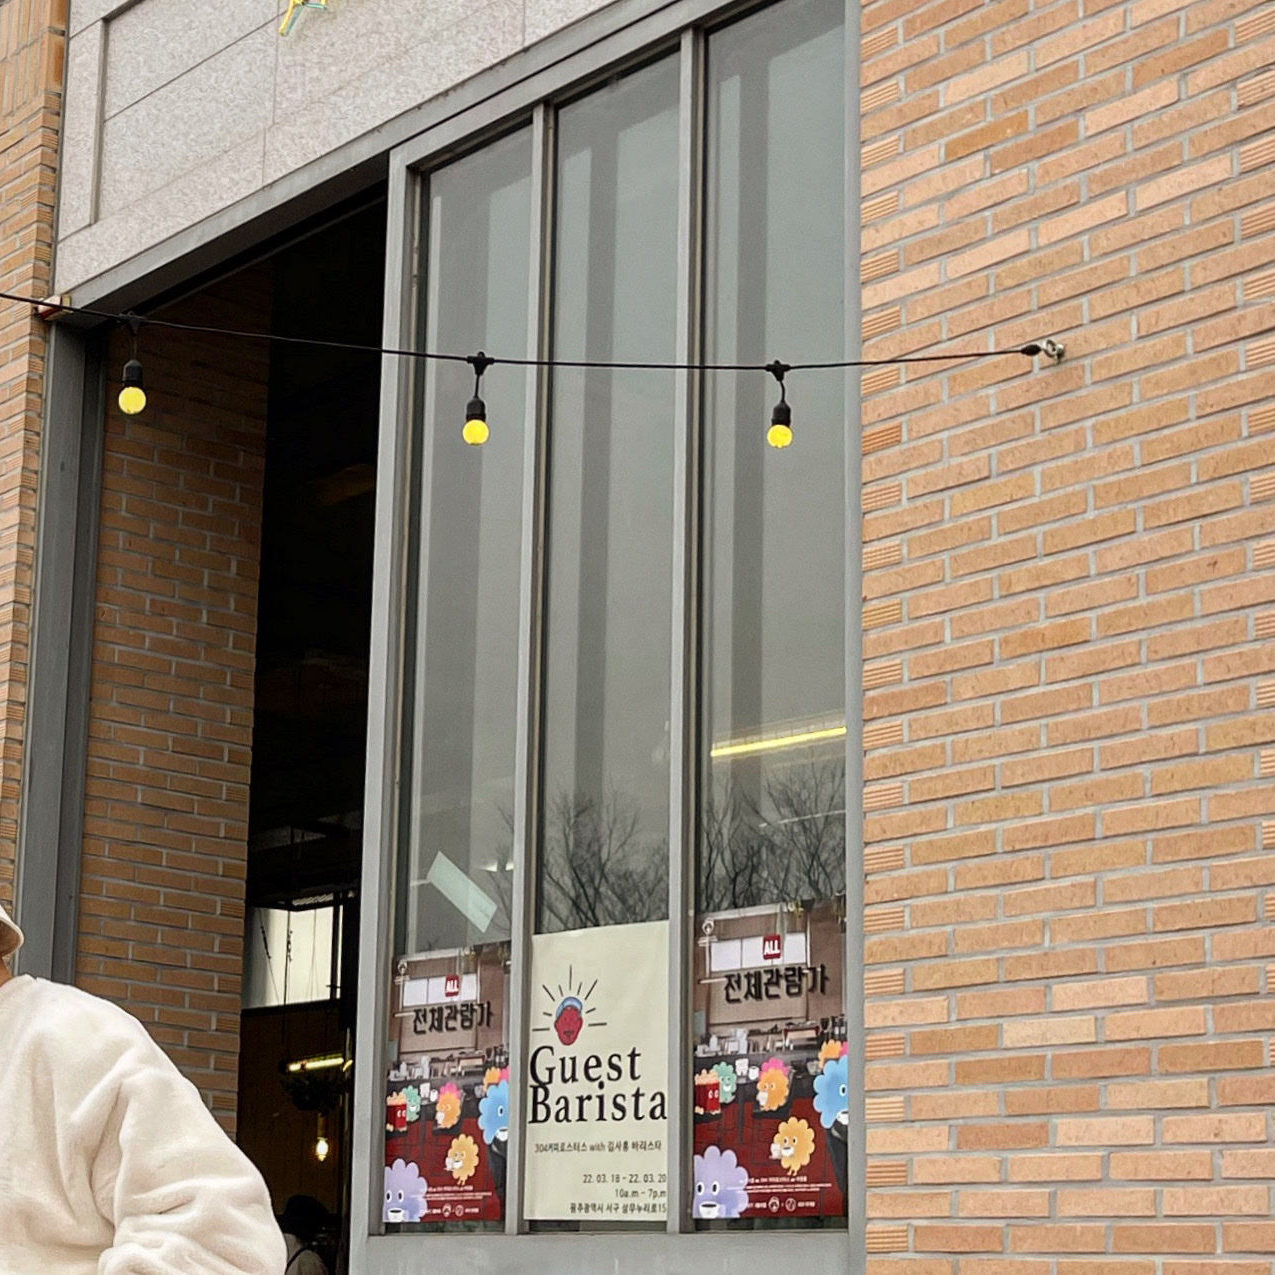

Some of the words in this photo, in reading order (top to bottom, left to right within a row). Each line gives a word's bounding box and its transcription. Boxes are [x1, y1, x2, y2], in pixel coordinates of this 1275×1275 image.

[764, 939, 781, 955] ALL
[446, 979, 460, 993] ALL
[724, 964, 830, 1004] 전체관람가
[413, 1000, 494, 1035] 전체관람가
[529, 1045, 642, 1086] Guest
[528, 1081, 668, 1124] Barista
[589, 1142, 605, 1152] with
[631, 1140, 662, 1152] 바리스타
